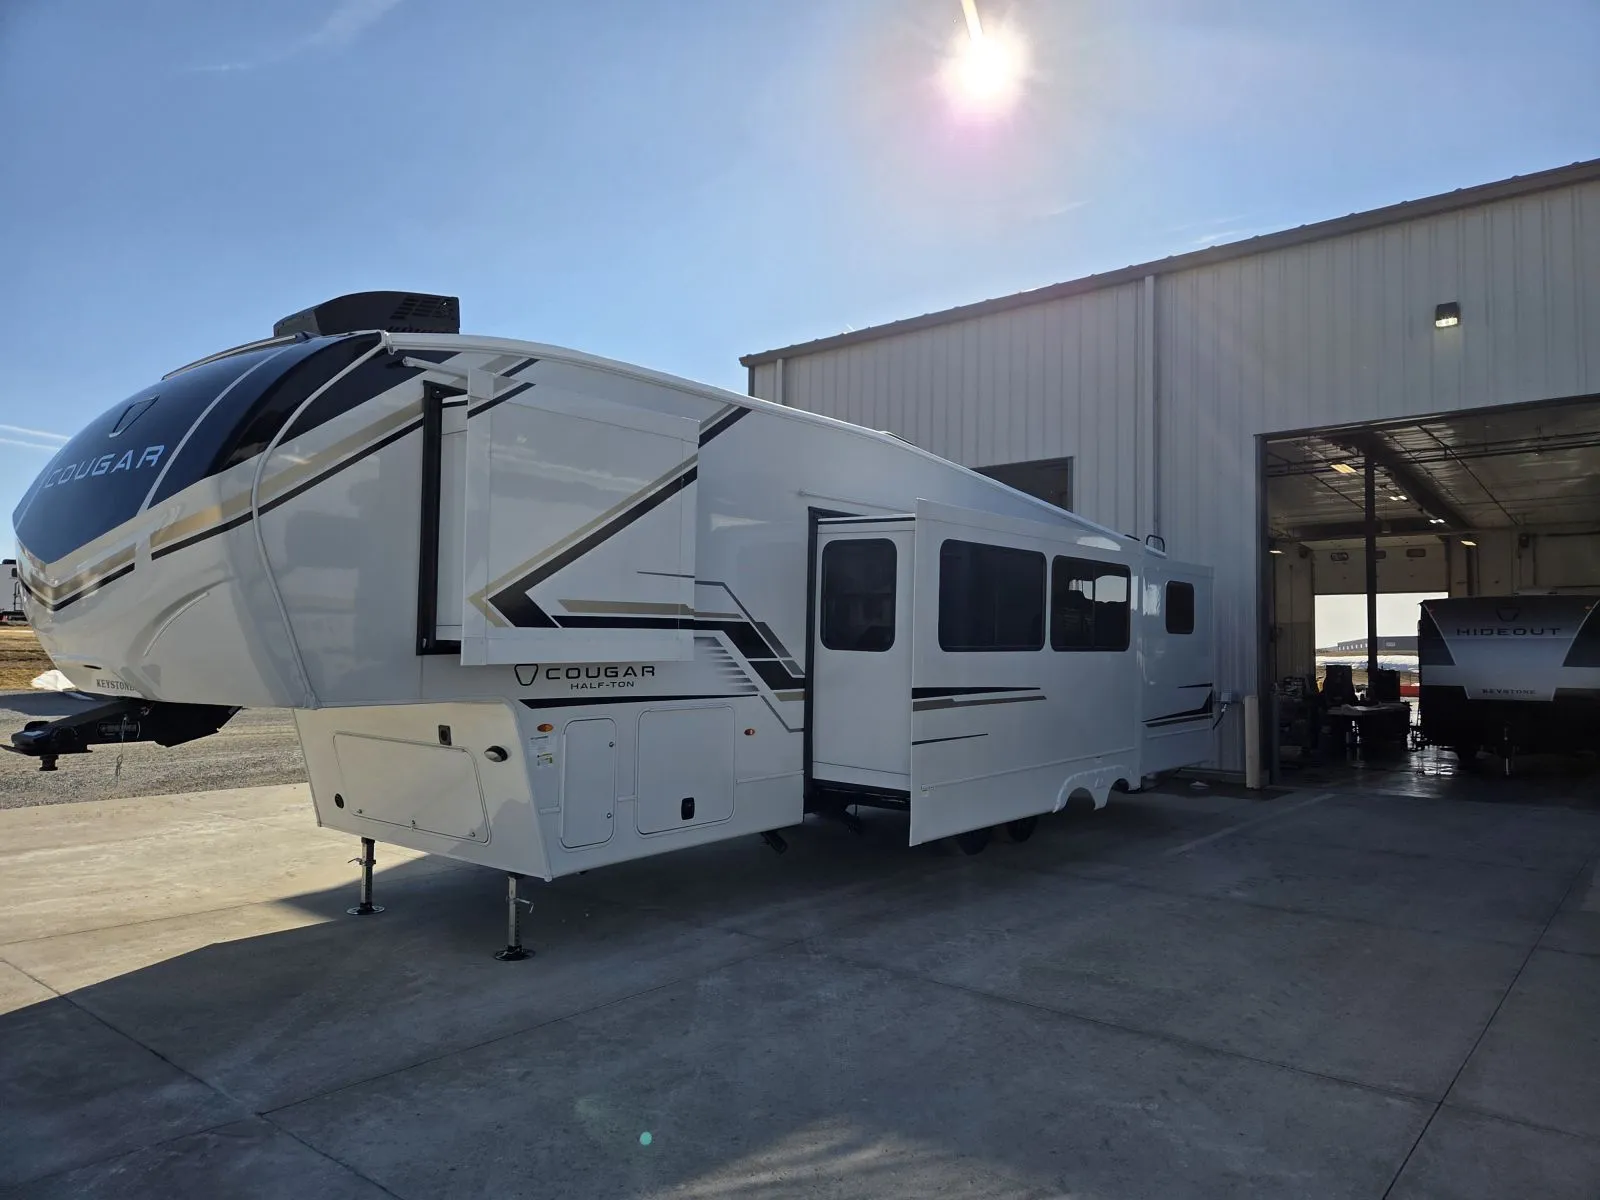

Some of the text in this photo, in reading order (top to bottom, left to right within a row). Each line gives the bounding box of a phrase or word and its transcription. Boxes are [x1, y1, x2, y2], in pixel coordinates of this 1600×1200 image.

[43, 445, 164, 488] COUGAR
[1457, 627, 1561, 636] HIDEOUT
[546, 666, 655, 680] COUGAR
[570, 681, 634, 690] HALF-TON
